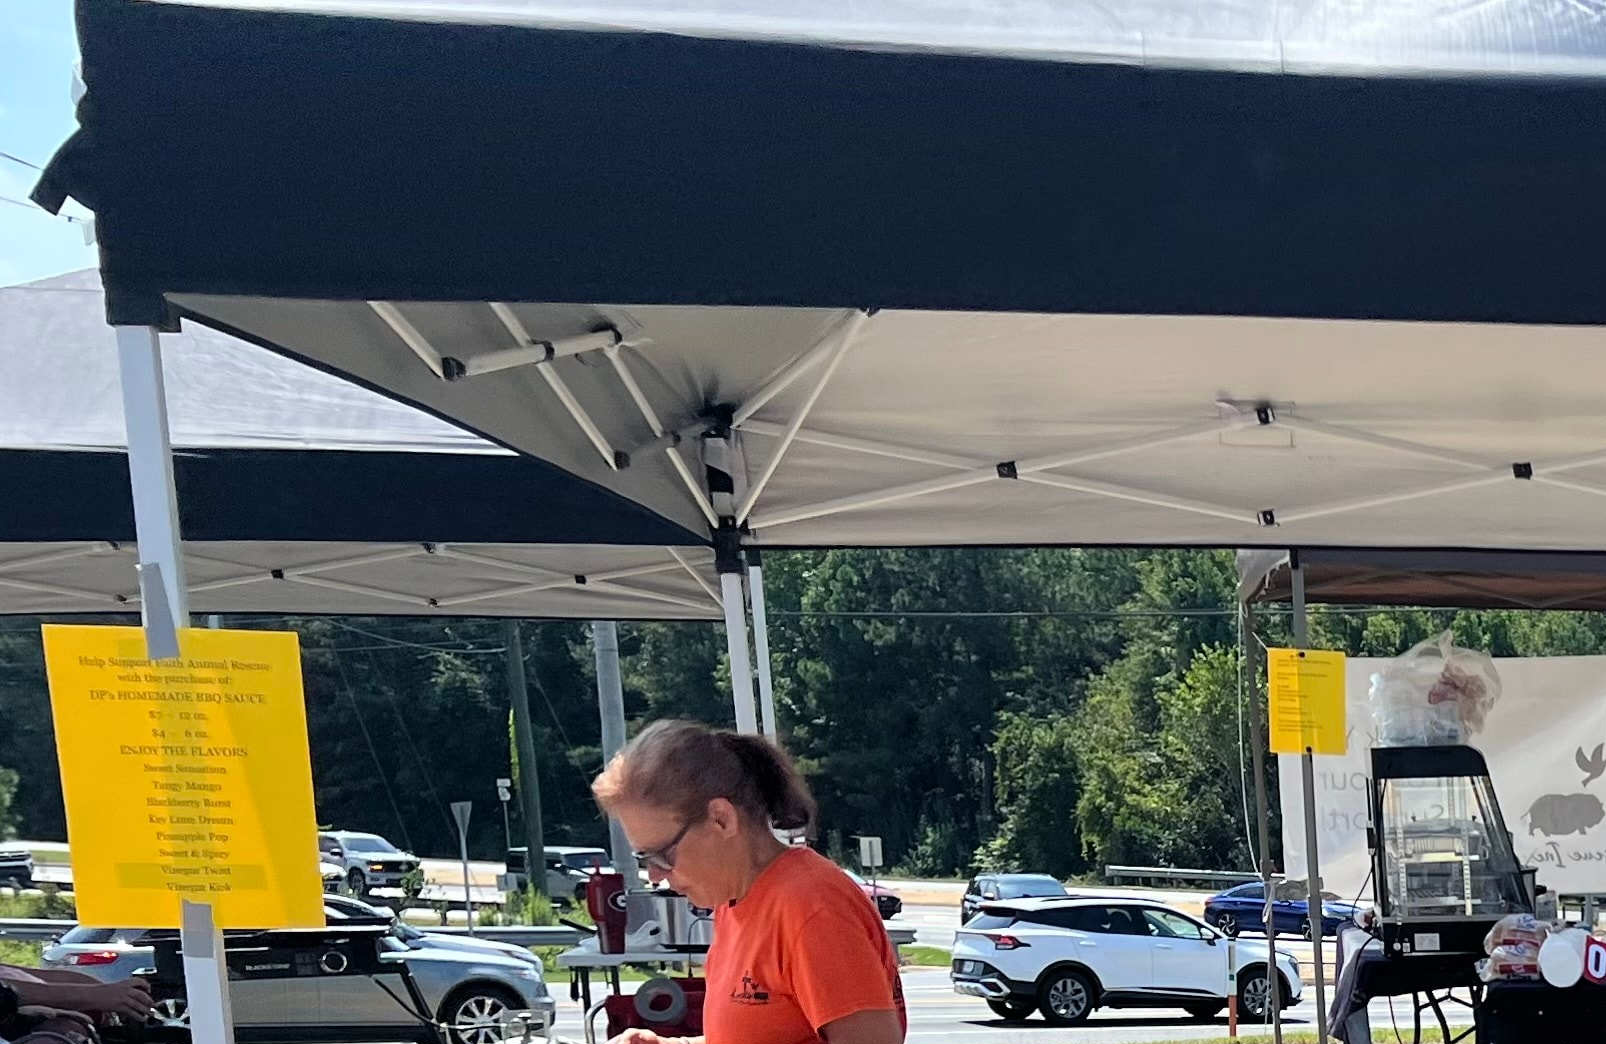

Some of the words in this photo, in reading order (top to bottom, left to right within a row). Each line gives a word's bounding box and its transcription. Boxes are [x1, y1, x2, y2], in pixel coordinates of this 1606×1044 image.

[78, 656, 106, 669] Help
[108, 657, 150, 671] Support
[187, 659, 228, 670] Animal
[231, 660, 271, 671] Rescue
[117, 673, 142, 682] with
[144, 673, 161, 683] the
[165, 674, 216, 687] purchase
[118, 690, 194, 702] HOMEMADE
[197, 692, 221, 704] BBQ
[225, 694, 265, 705] SAUCE
[120, 745, 160, 756] ENJOY
[162, 745, 187, 756] THE
[191, 746, 248, 758] FLAVORS
[152, 781, 182, 792] Tangy
[186, 782, 222, 793] Mango
[146, 797, 200, 809] Blackberry
[148, 814, 166, 825] Key
[209, 832, 229, 843] Pop
[202, 849, 230, 860] Spicy
[161, 865, 200, 876] Vinegar
[166, 881, 206, 892] Vinegar
